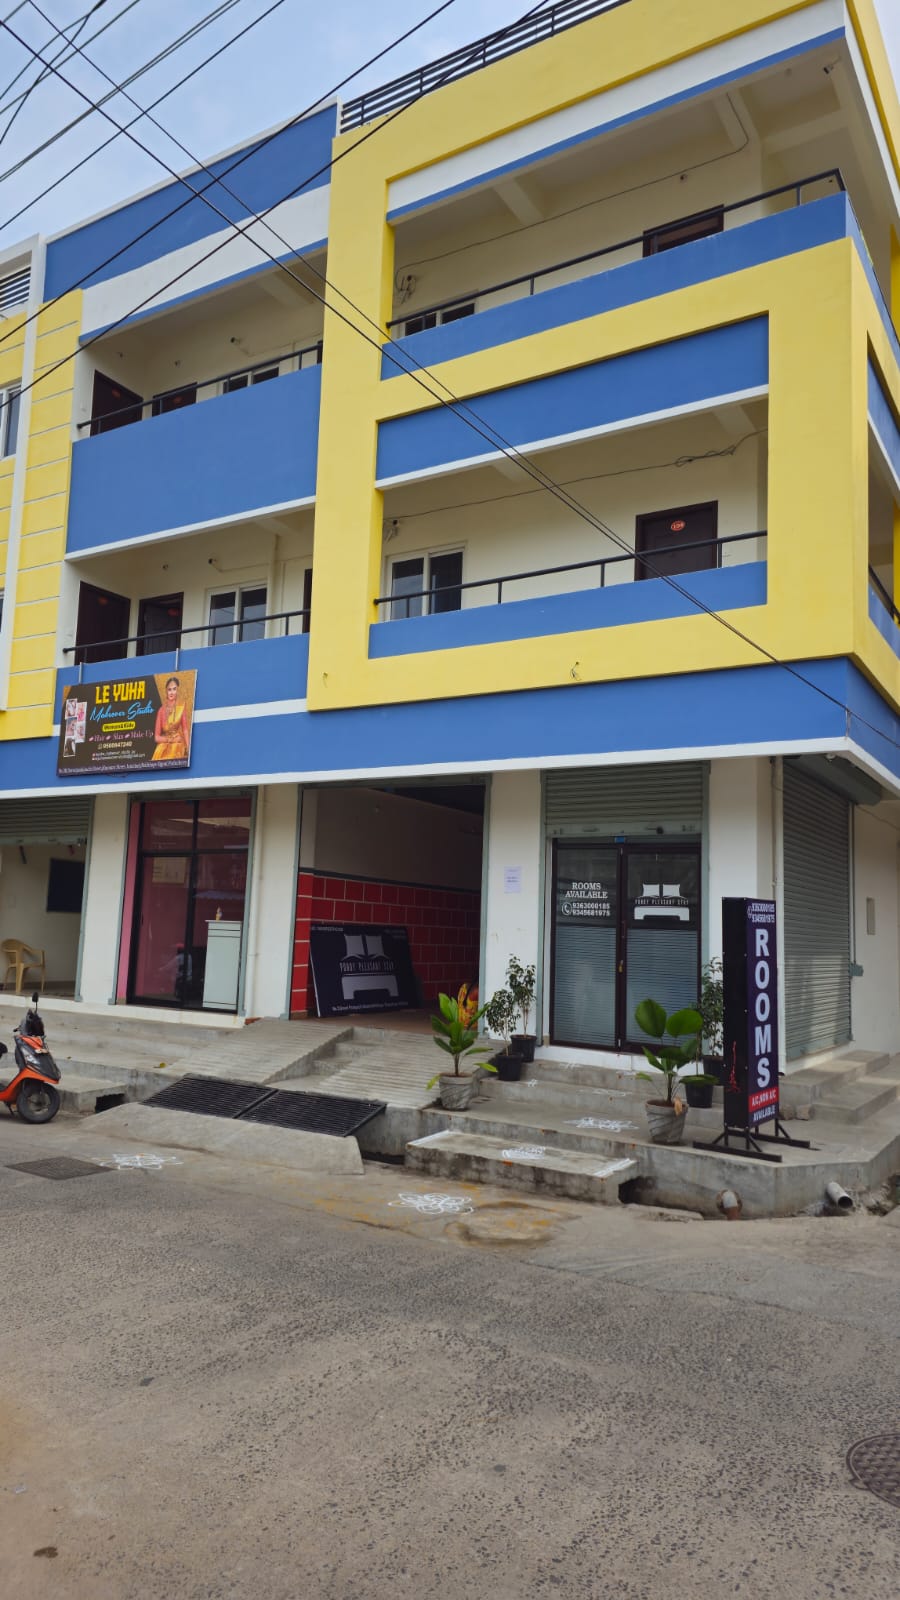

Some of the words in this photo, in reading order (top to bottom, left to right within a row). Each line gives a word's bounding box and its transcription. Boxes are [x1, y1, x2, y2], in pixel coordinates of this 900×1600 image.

[95, 685, 110, 704] LE
[113, 681, 145, 701] YUHA
[127, 700, 154, 720] Studio
[572, 882, 601, 890] ROOMS
[565, 890, 608, 899] AVAILABLE
[572, 902, 610, 910] 9363000185
[755, 928, 771, 1088] ROOMS
[753, 1105, 775, 1121] AVAILABLE
